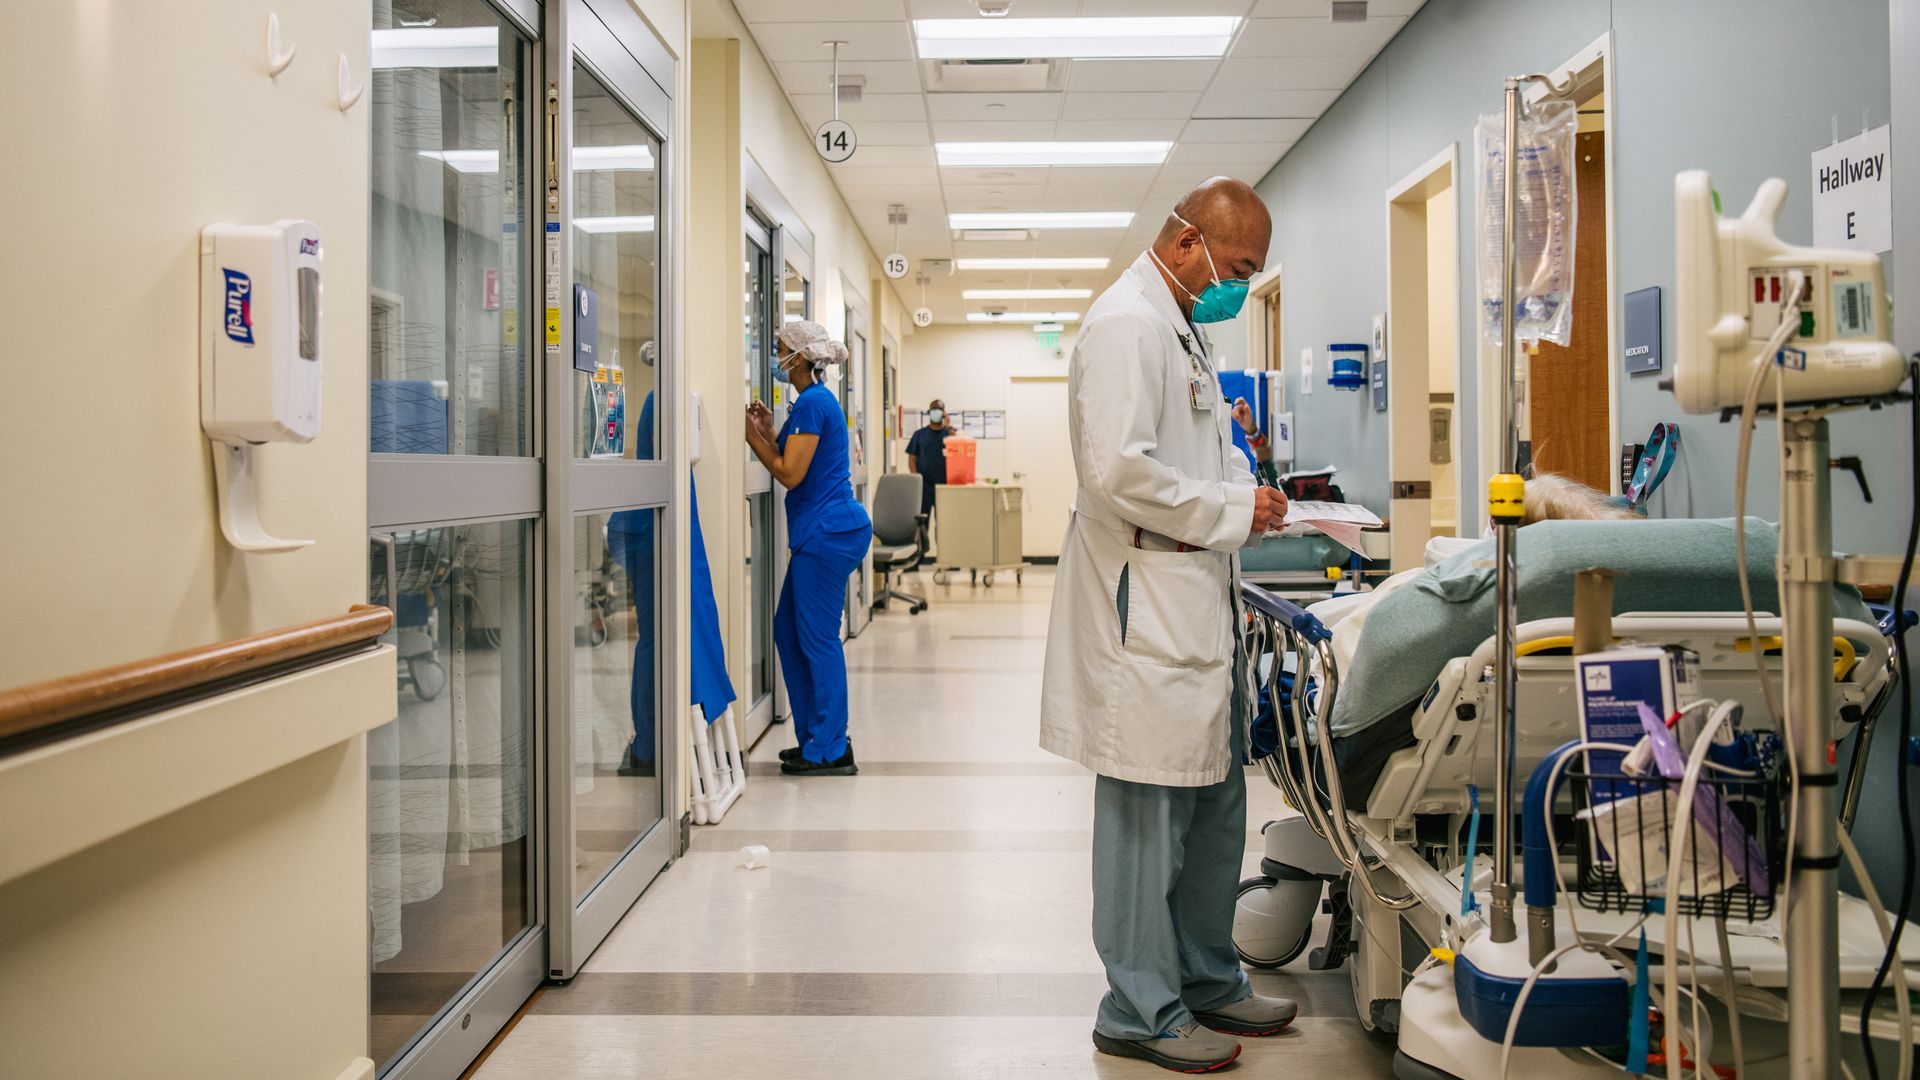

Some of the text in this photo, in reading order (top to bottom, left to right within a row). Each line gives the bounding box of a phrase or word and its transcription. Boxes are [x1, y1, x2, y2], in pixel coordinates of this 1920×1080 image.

[821, 130, 848, 152] 14
[1820, 153, 1884, 194] Hallway
[1847, 211, 1856, 240] E
[887, 259, 904, 273] 15
[227, 277, 250, 338] Purell
[916, 312, 929, 323] 16
[1625, 345, 1649, 357] MEDICATION
